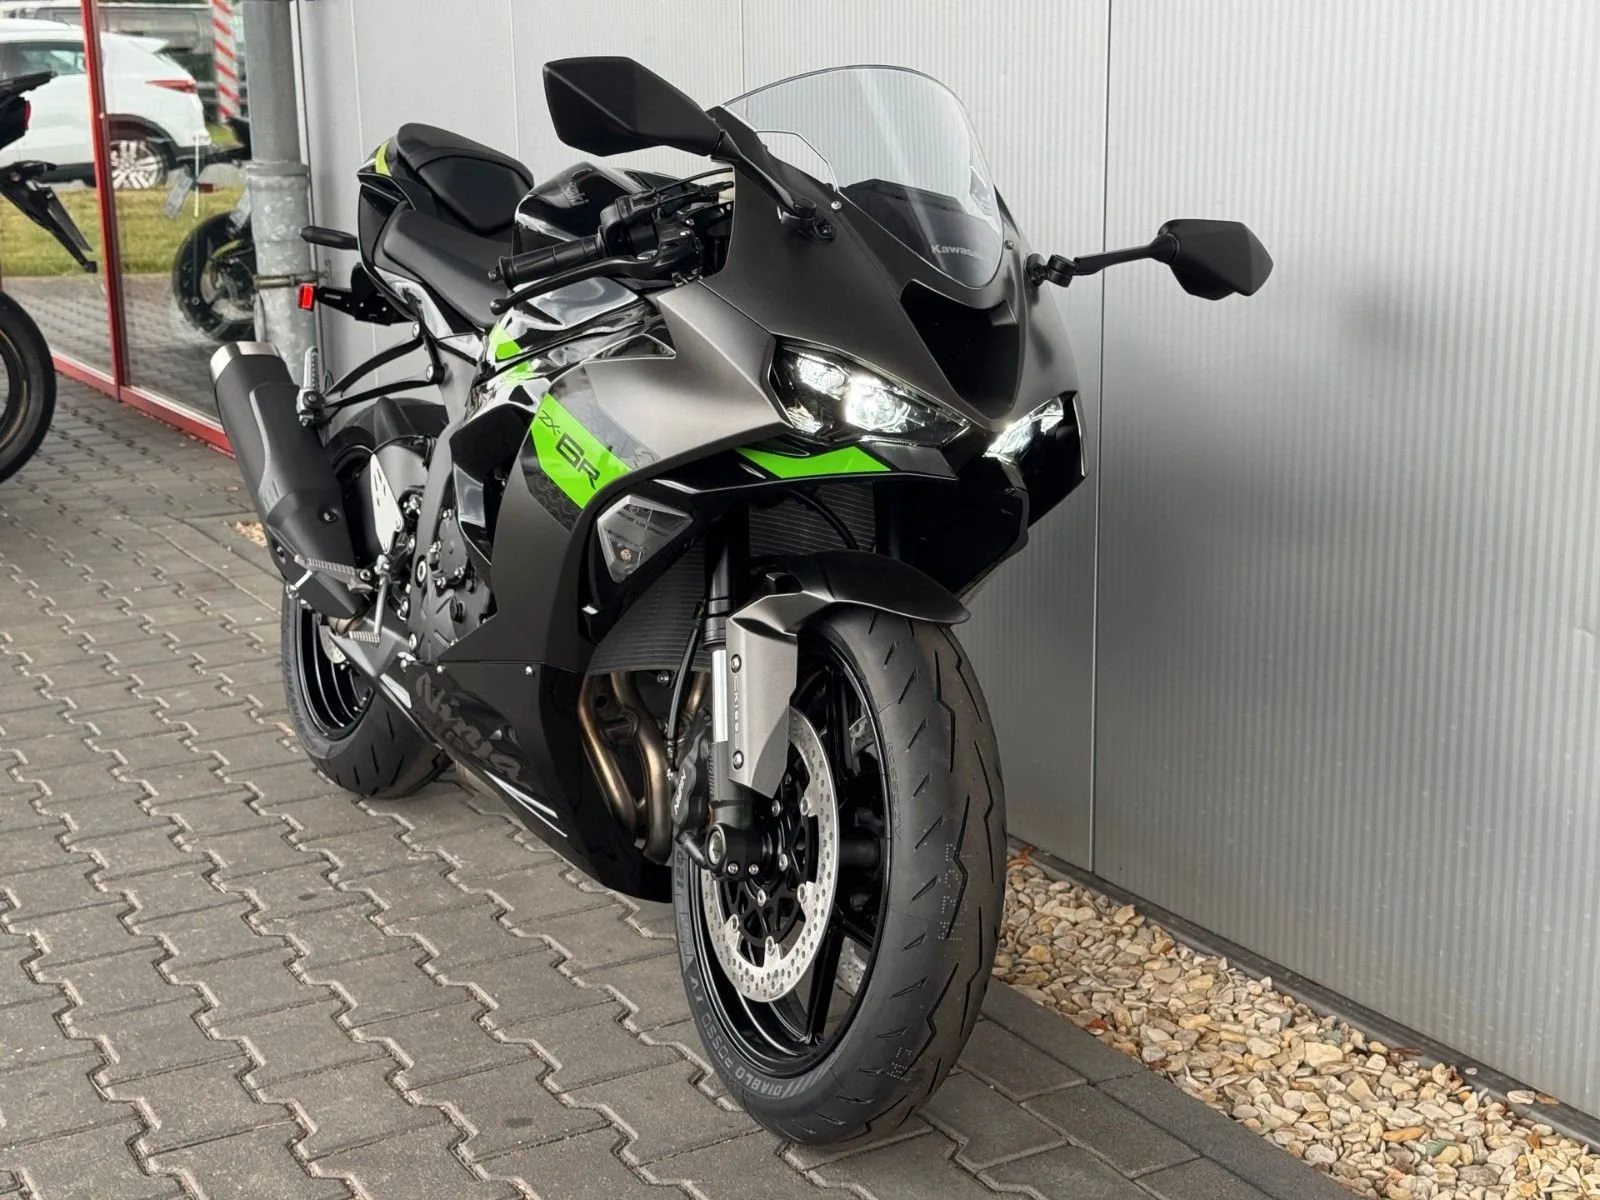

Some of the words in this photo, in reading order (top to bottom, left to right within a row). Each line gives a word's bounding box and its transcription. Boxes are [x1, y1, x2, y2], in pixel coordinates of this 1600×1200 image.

[538, 410, 601, 490] ZX-6R
[416, 672, 533, 792] Ninja
[702, 1012, 735, 1069] ROSSO
[734, 1066, 784, 1097] DIABLO
